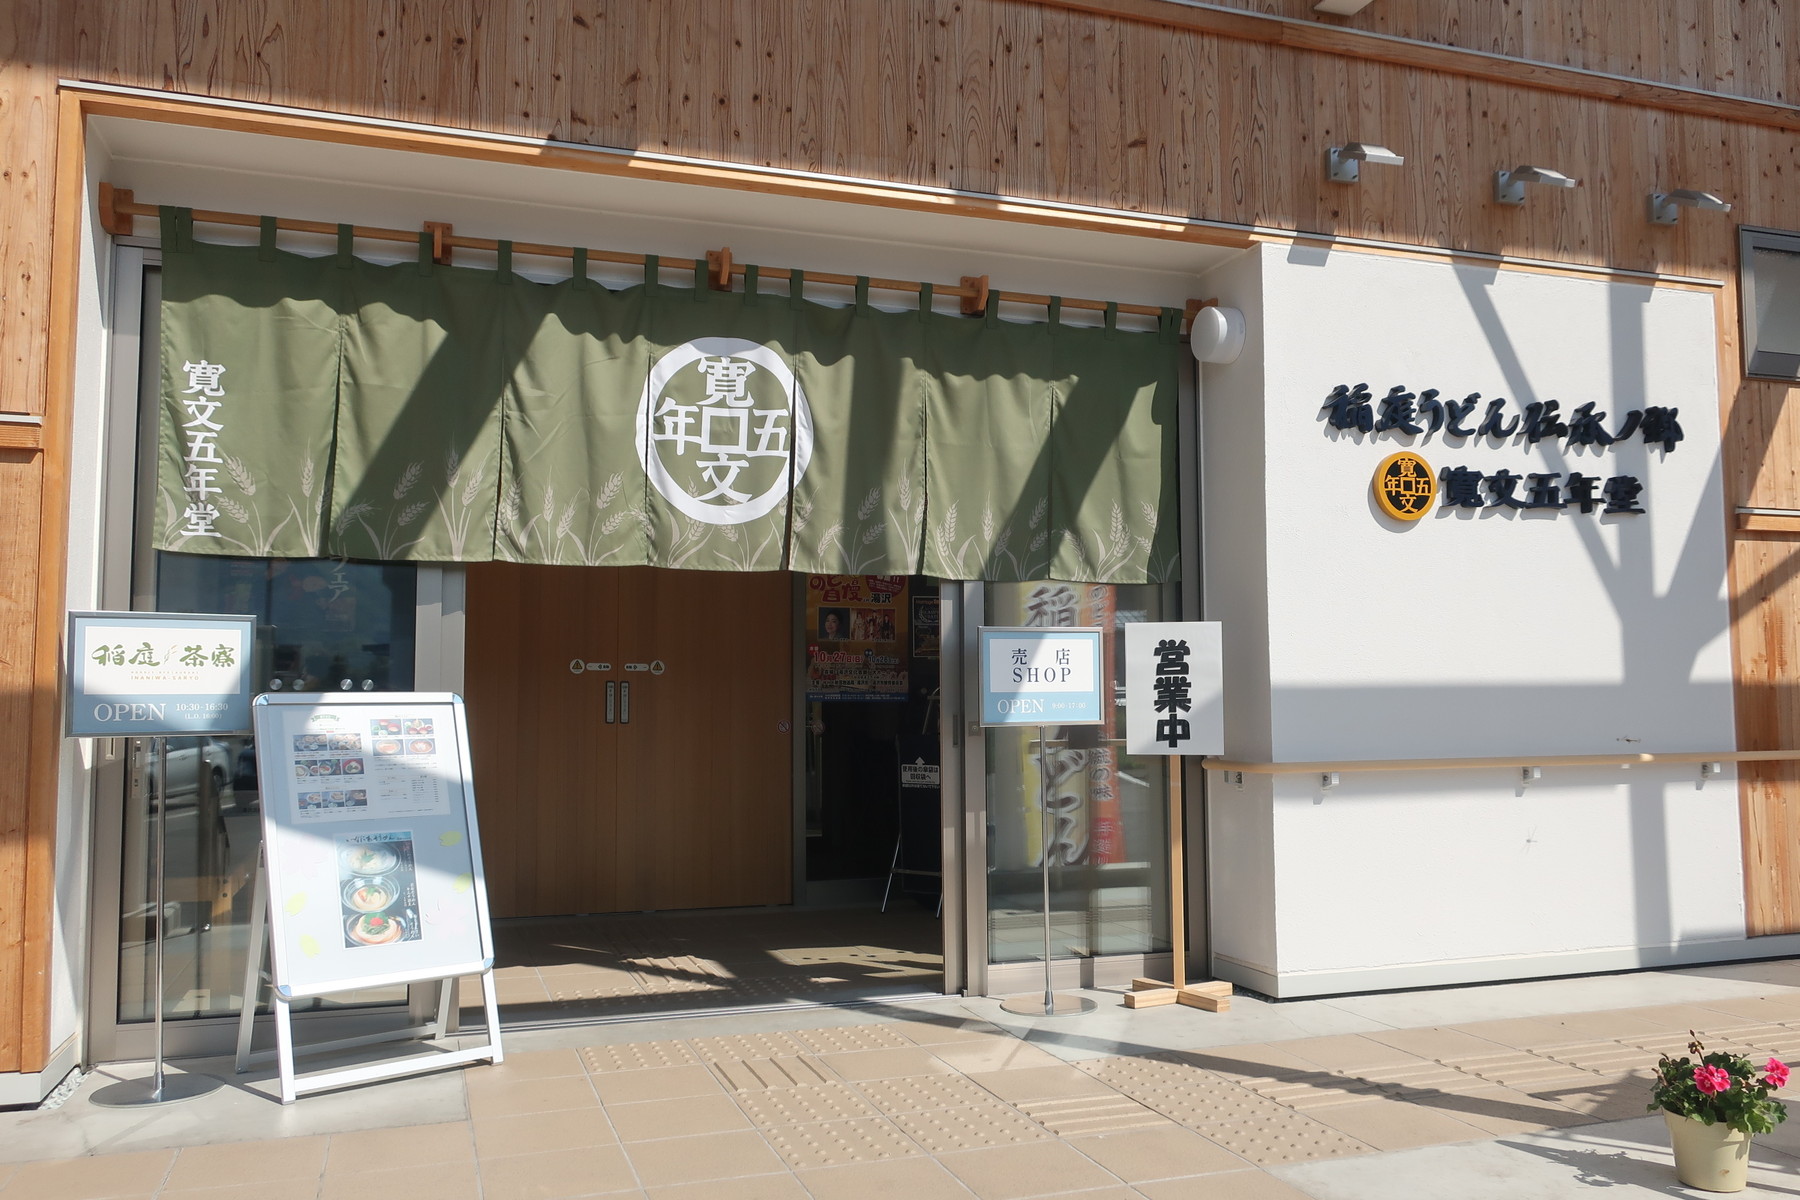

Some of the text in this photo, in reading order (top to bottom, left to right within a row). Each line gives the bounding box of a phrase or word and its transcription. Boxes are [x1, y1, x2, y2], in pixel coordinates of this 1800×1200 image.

[180, 359, 226, 538] 寛文五年堂
[1012, 667, 1072, 683] SHOP
[1153, 639, 1192, 748] 営業中
[93, 703, 166, 722] OPEN
[997, 699, 1045, 715] OPEN
